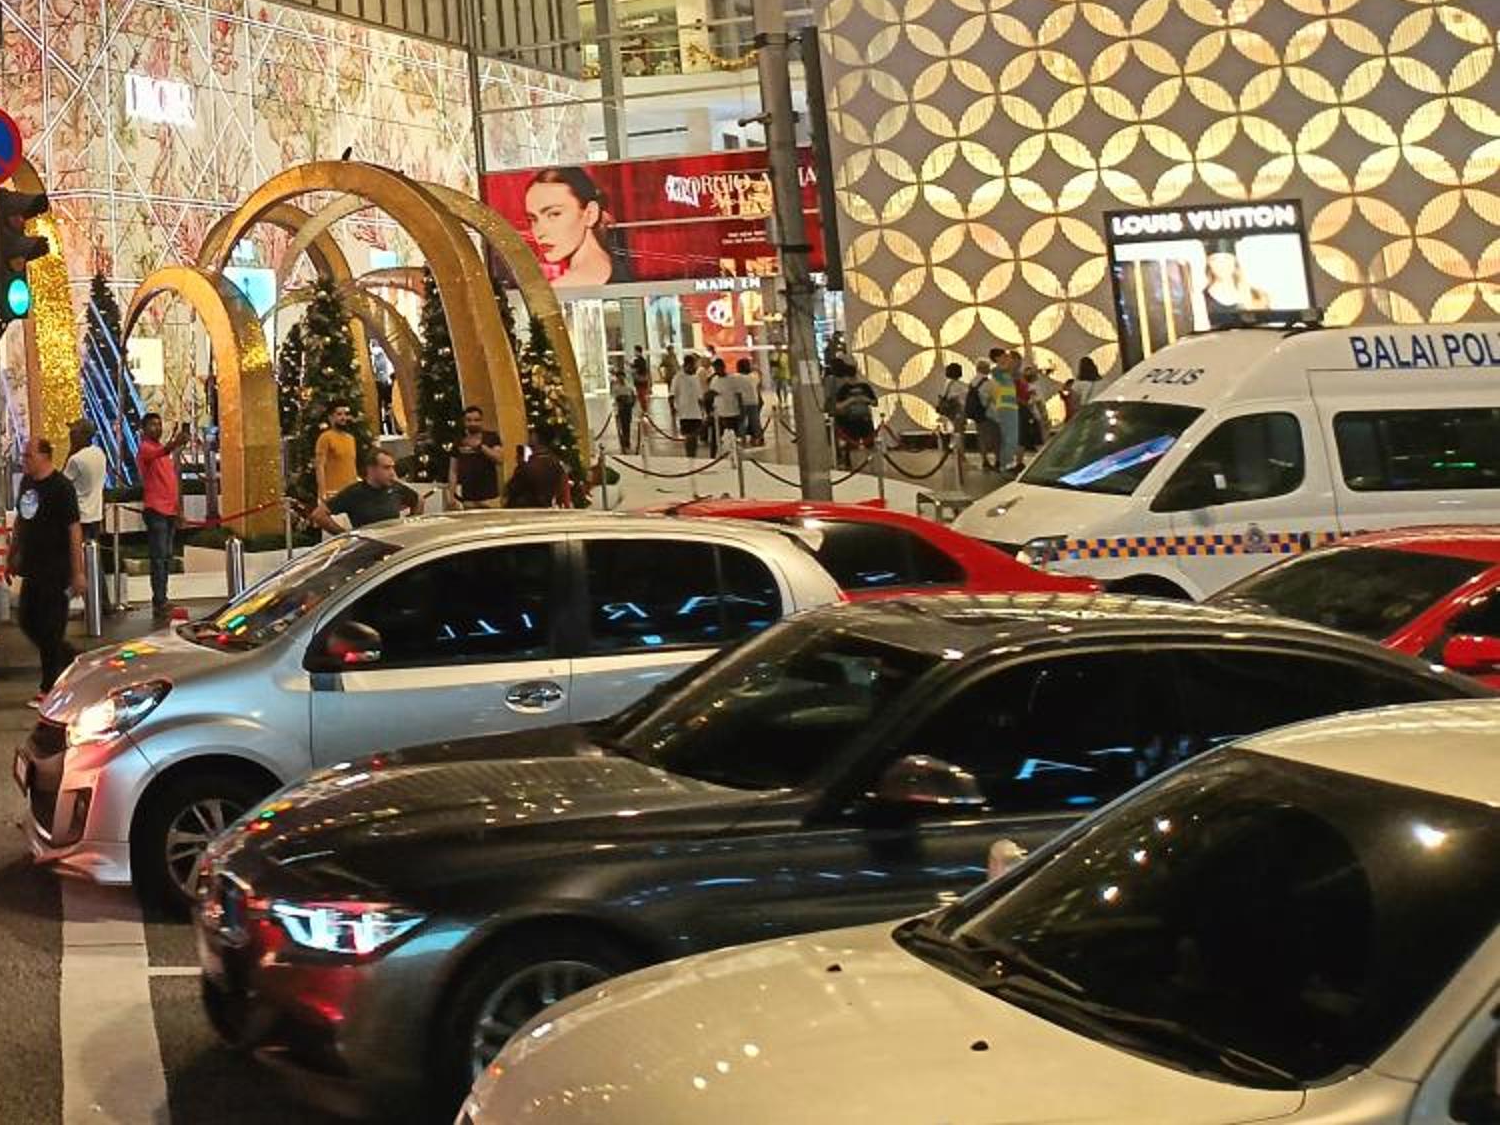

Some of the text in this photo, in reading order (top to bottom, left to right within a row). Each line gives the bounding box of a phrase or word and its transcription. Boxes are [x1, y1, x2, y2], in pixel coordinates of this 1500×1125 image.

[1112, 204, 1297, 236] LOUIS VUITTON
[695, 278, 735, 291] MAIN
[1349, 332, 1500, 368] BALAI POL
[1140, 367, 1204, 385] POLIS
